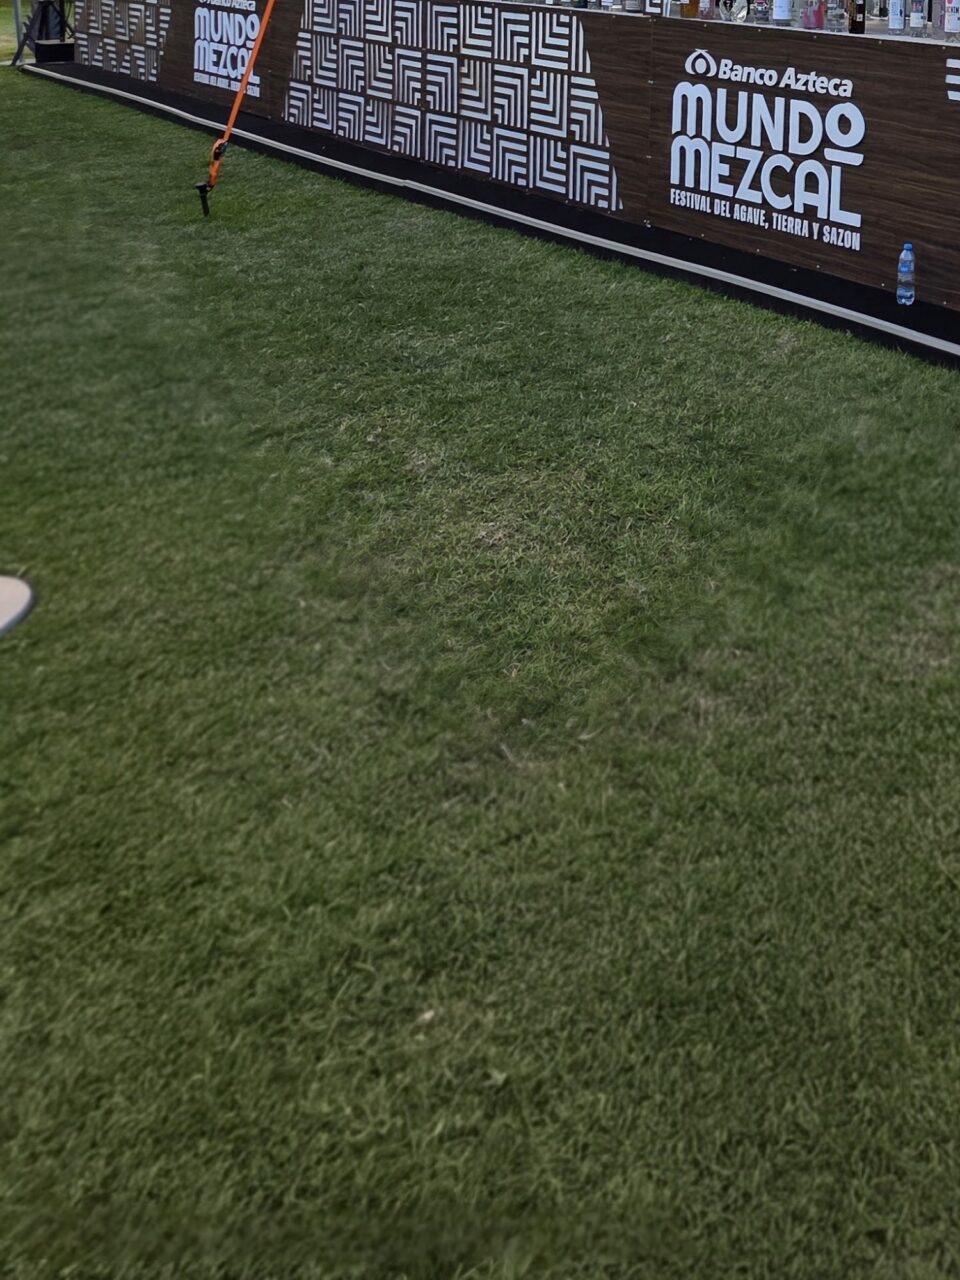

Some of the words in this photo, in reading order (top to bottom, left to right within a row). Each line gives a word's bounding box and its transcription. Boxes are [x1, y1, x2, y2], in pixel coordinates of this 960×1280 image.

[194, 6, 260, 46] MUNDO
[718, 58, 778, 87] Banco
[779, 67, 854, 98] Azteca
[671, 81, 866, 156] MUNDO
[670, 134, 862, 227] MEZCAL
[670, 188, 712, 213] FESTIVAL
[713, 201, 731, 218] DEL
[733, 204, 769, 230] AGAVE,
[772, 212, 809, 238] TIERRA
[812, 222, 820, 240] Y
[822, 225, 861, 252] SAZON
